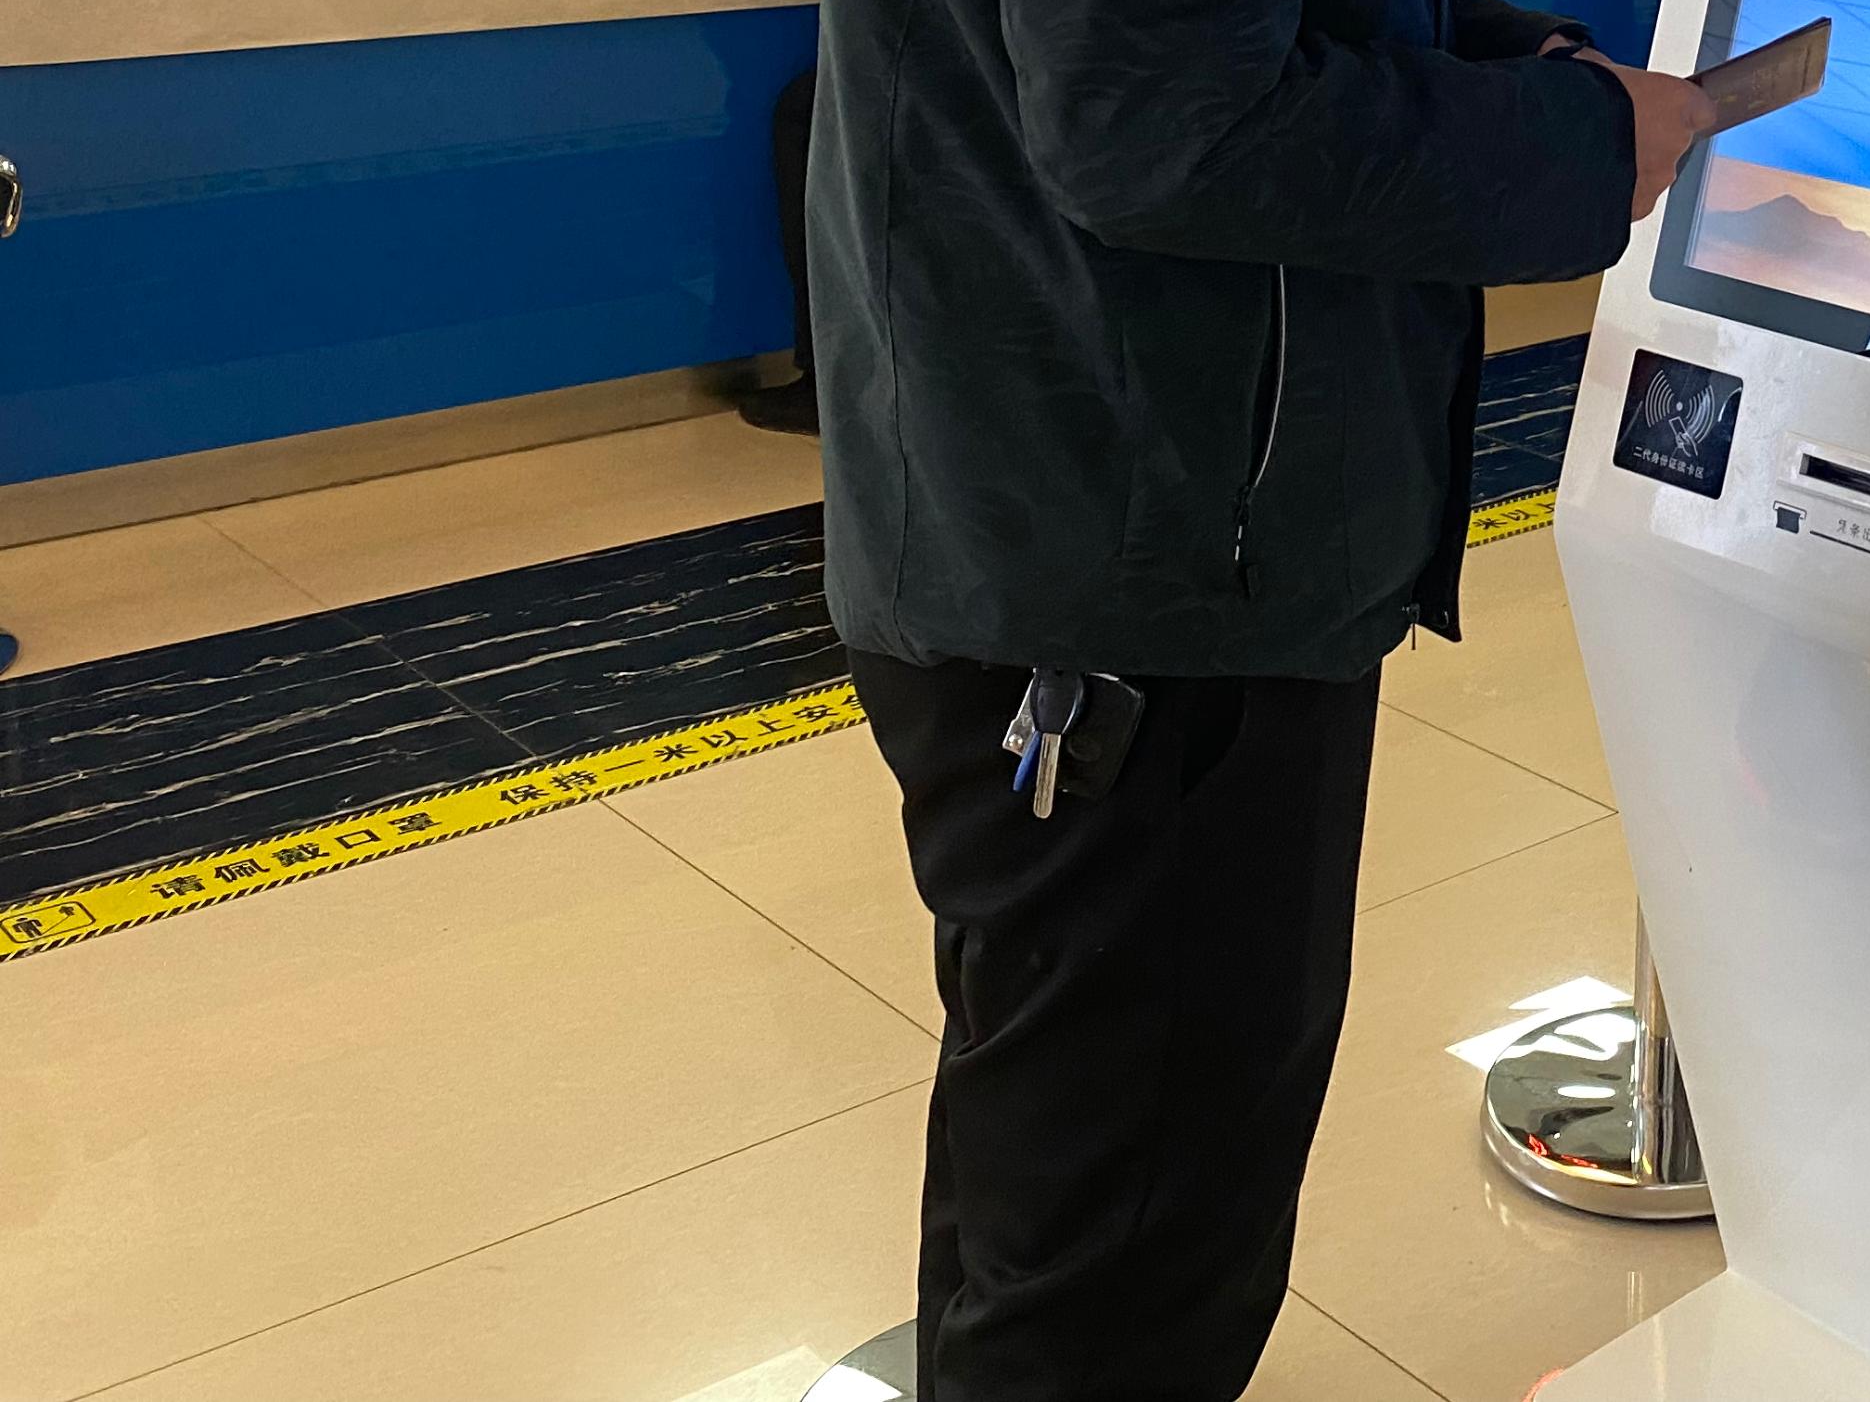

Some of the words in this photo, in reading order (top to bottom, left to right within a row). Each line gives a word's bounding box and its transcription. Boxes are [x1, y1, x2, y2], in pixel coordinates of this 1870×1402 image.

[147, 810, 444, 902] 请佩戴口罩
